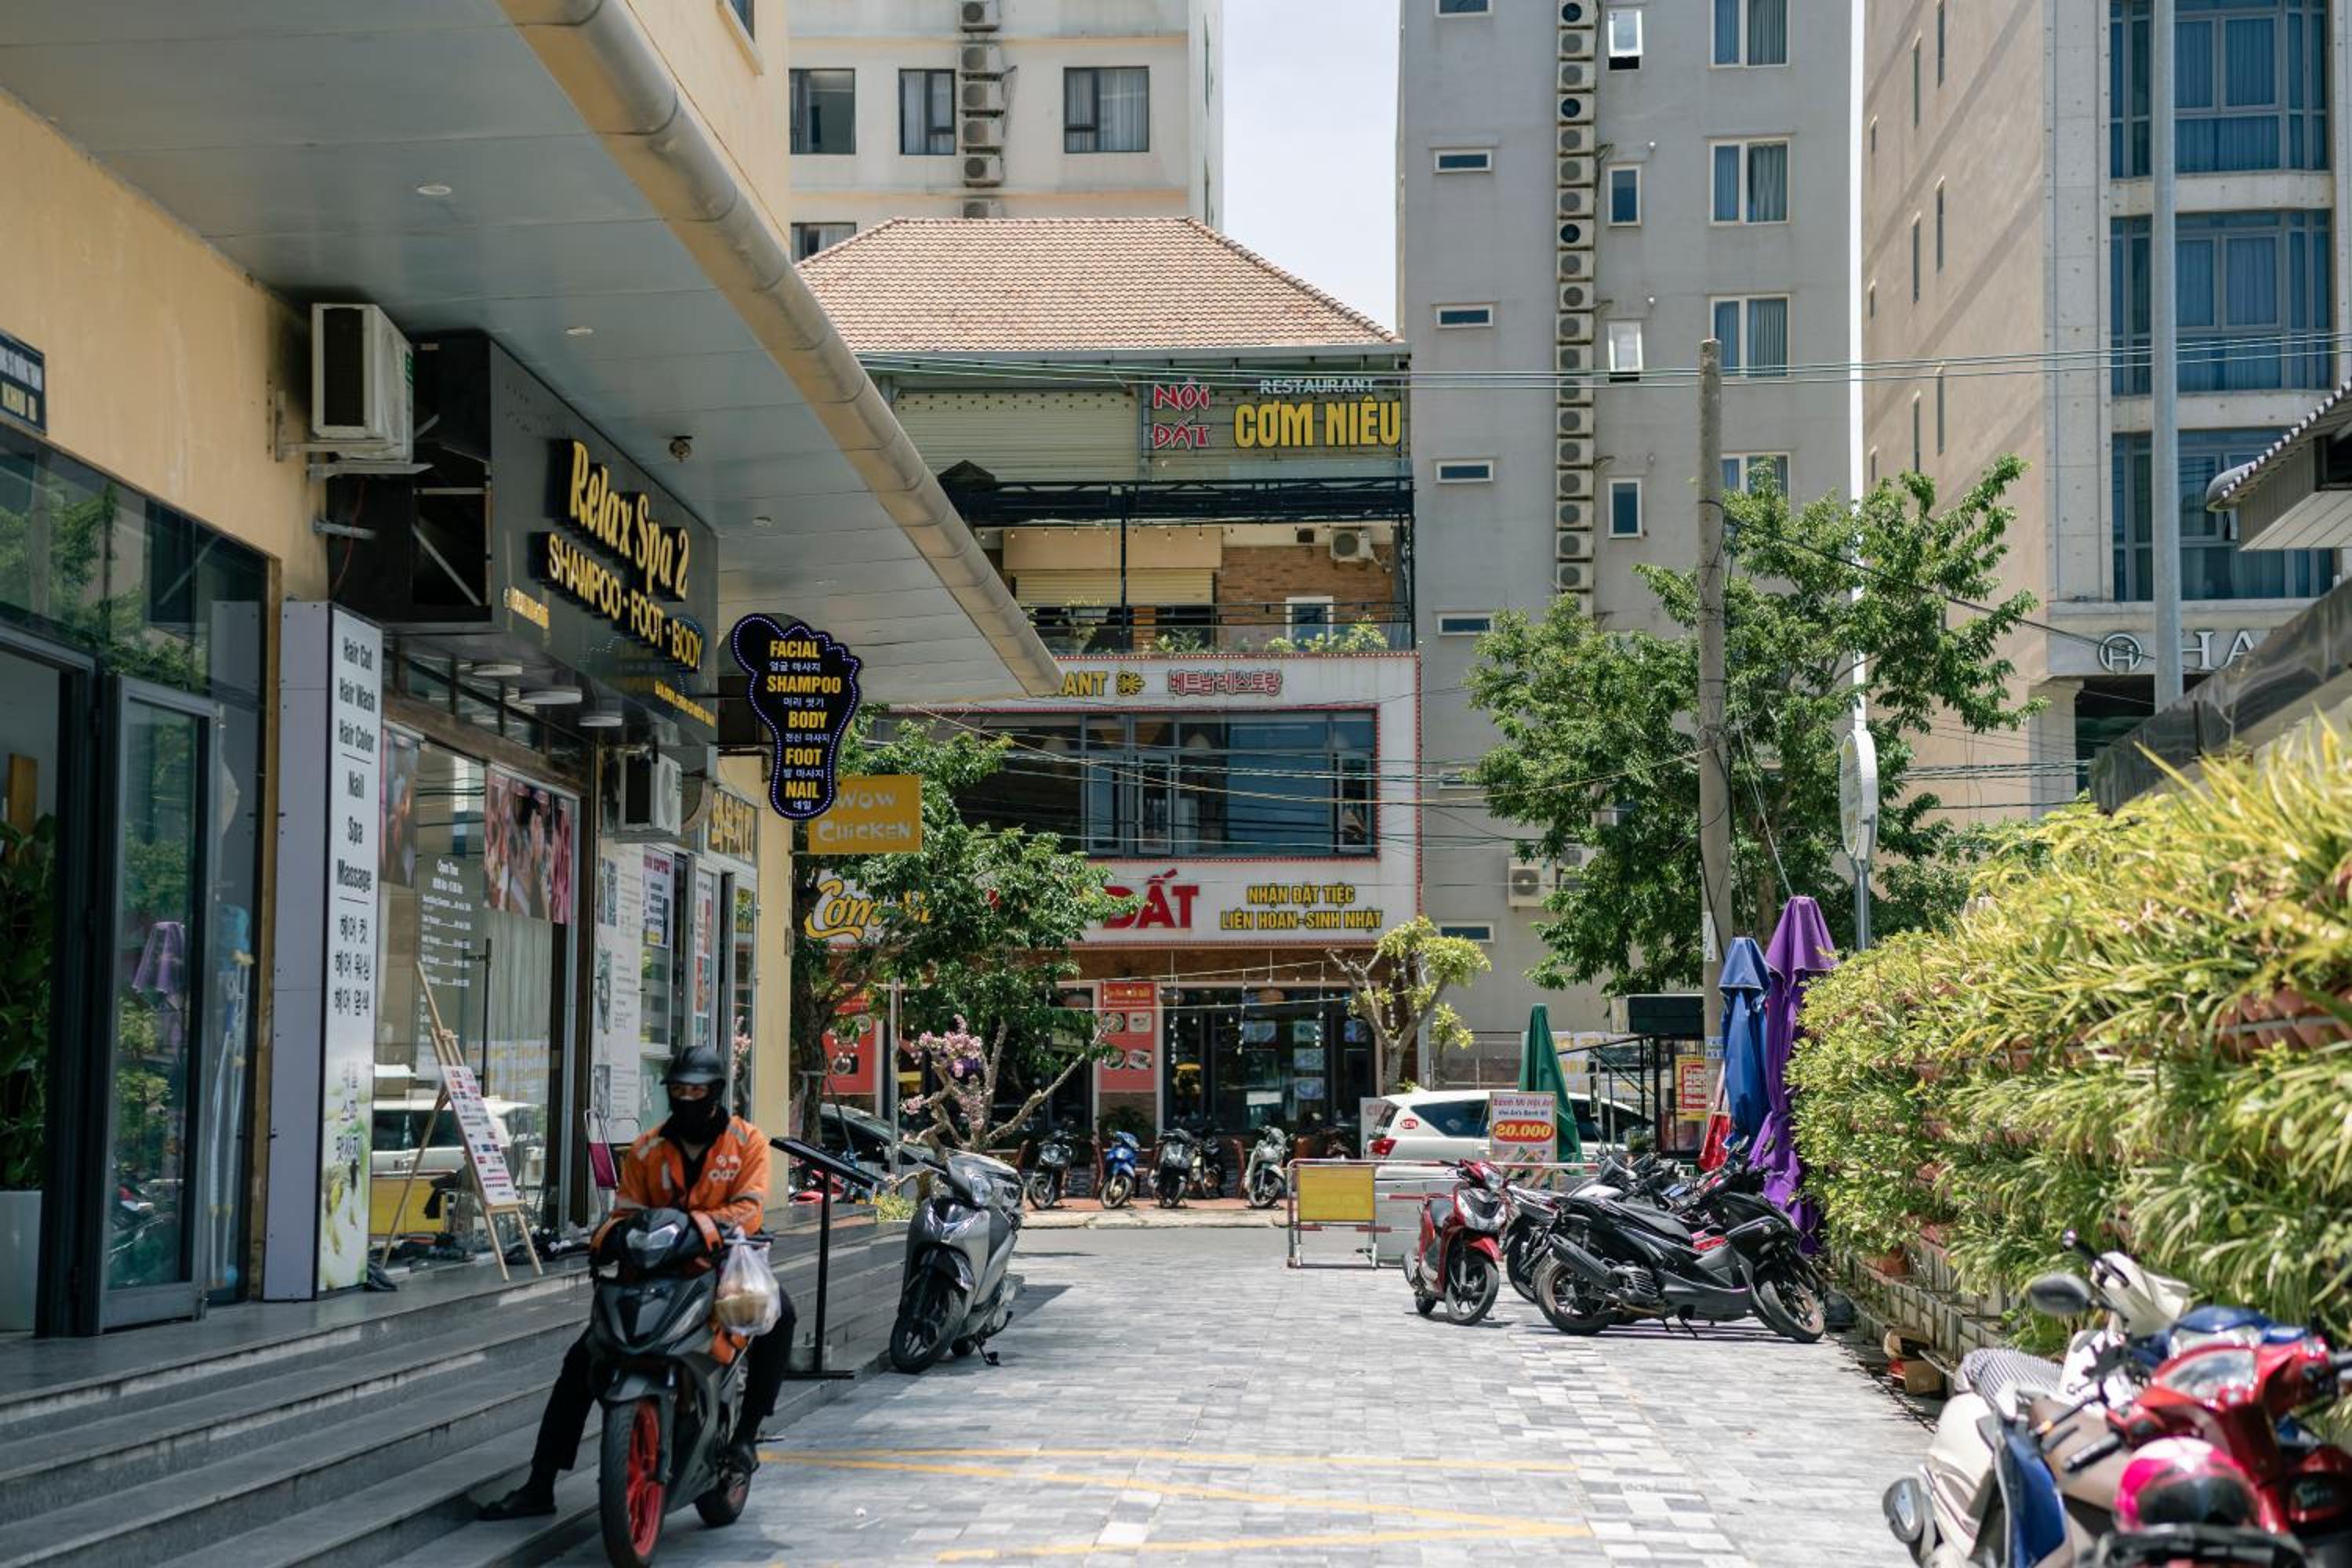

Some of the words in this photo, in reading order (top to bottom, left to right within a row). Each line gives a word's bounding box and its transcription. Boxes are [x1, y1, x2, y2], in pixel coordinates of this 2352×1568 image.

[1259, 378, 1375, 395] RESTAURANT
[1233, 400, 1314, 448] CƠM
[1325, 394, 1402, 447] NIÊU
[570, 440, 633, 558] Relax
[636, 492, 673, 594] Spa
[675, 527, 690, 601] 2
[548, 532, 622, 620] SHAMPOO
[630, 588, 665, 648] FOOT
[672, 618, 702, 670] BODY
[343, 637, 358, 665] Hair
[359, 644, 372, 671] Cut
[769, 641, 821, 659] FACIAL
[339, 677, 354, 705] Hair
[356, 684, 376, 713] Wash
[766, 675, 841, 694] SHAMPOO
[1060, 670, 1109, 696] ANT
[788, 711, 828, 729] BODY
[339, 719, 354, 746] Hair
[355, 724, 375, 753] Color
[785, 748, 822, 766] FOOT
[347, 770, 365, 800] Nail
[785, 781, 820, 799] NAIL
[347, 815, 363, 845] Spa
[337, 858, 372, 893] Massage
[1495, 1123, 1552, 1138] 20.000
